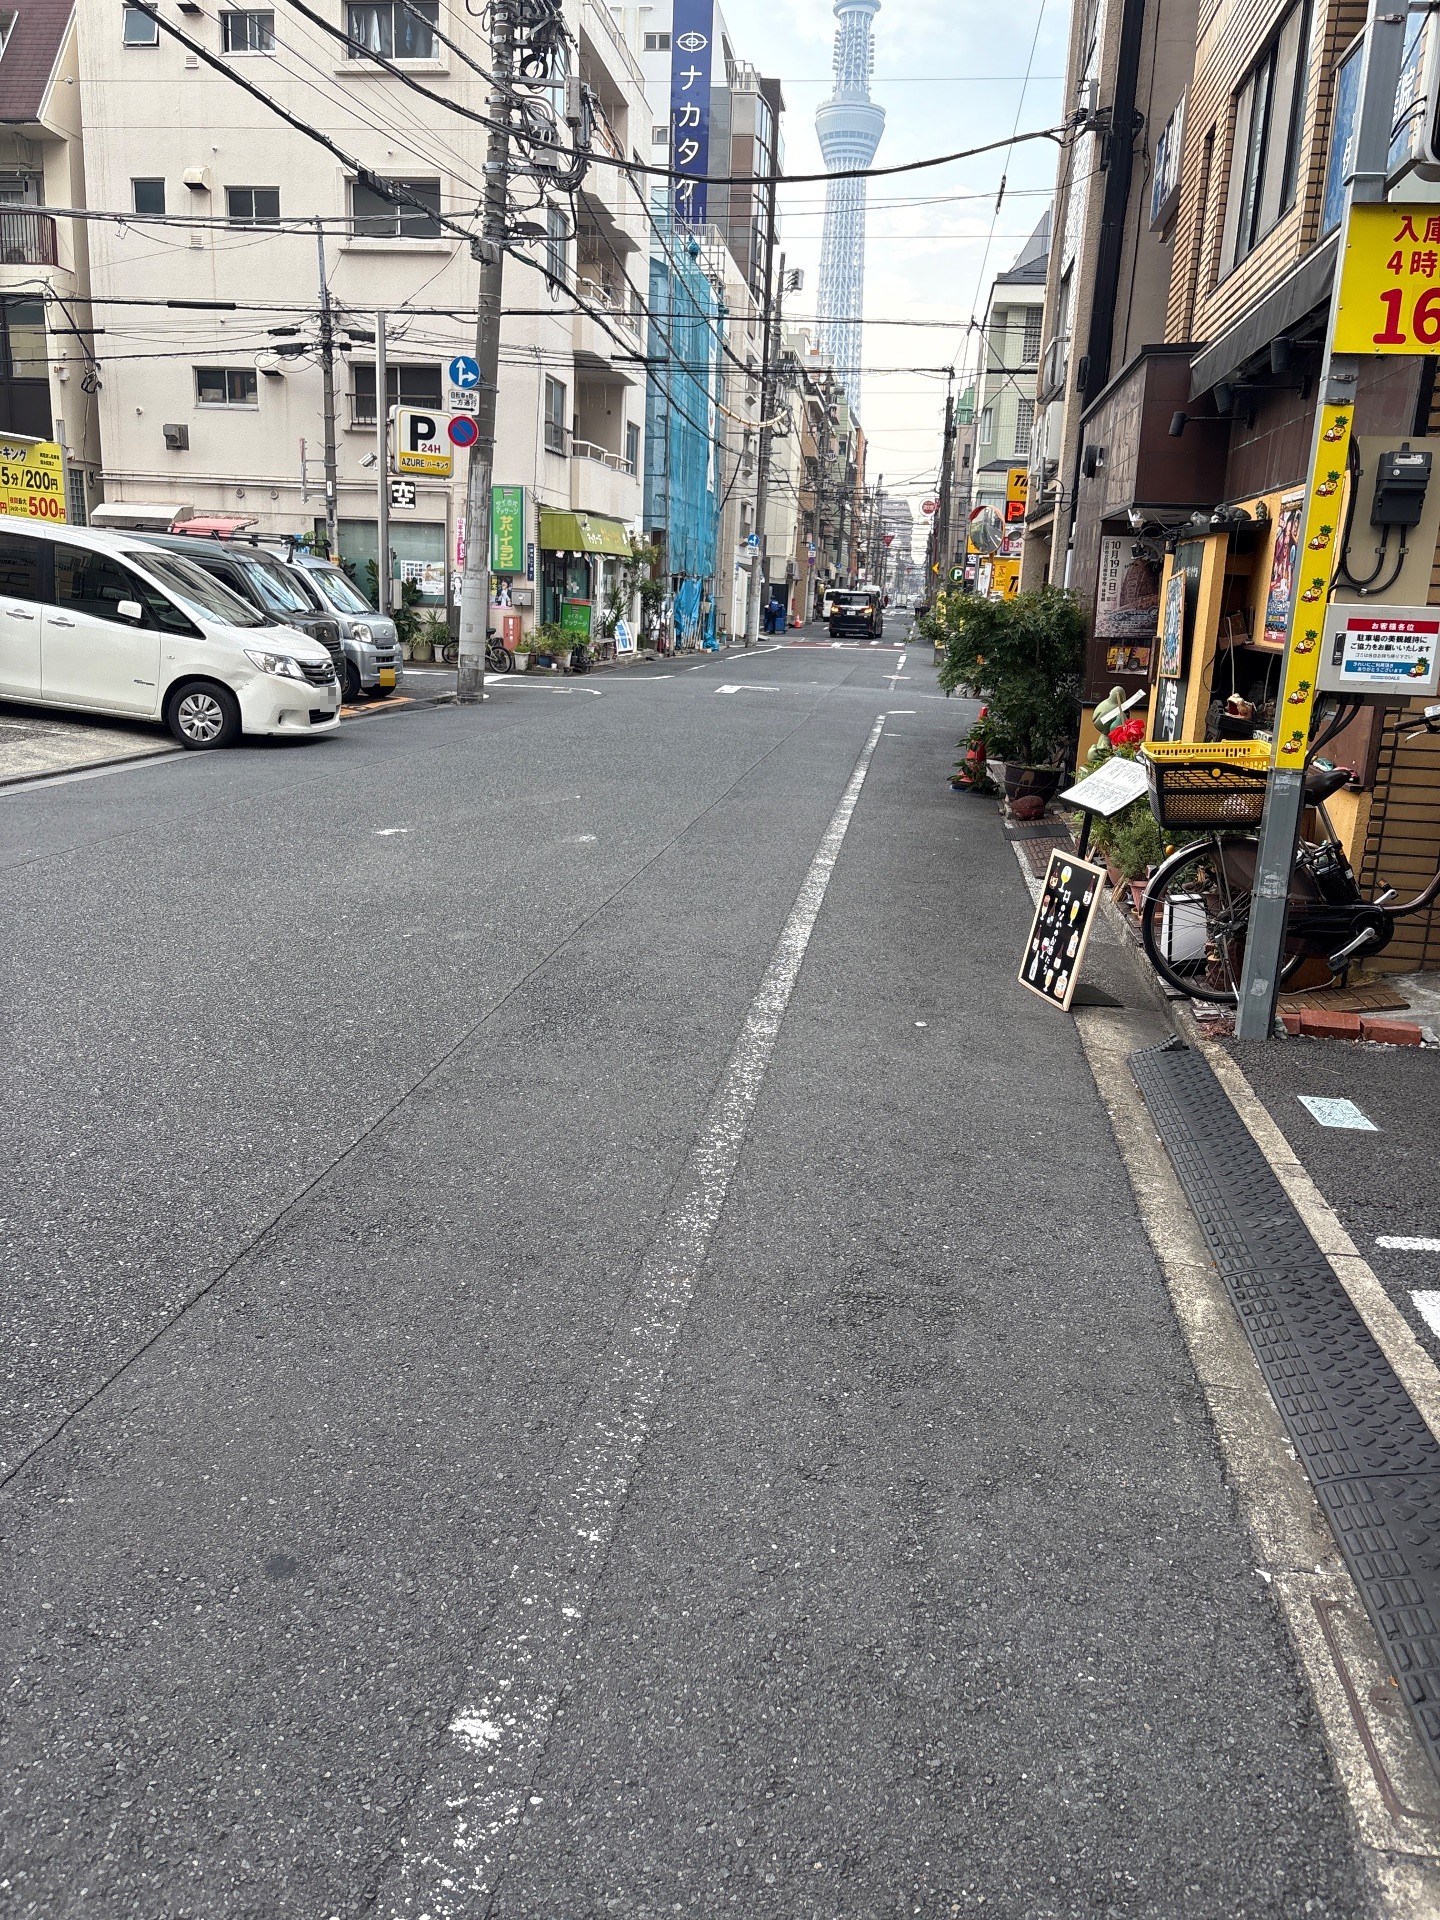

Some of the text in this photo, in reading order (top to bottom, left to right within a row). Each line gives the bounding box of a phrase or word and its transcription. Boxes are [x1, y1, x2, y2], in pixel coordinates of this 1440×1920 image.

[450, 392, 477, 401] 自転車を除く
[410, 414, 436, 452] P
[421, 443, 441, 454] 24H
[401, 457, 449, 469] AZURE パーキング
[392, 481, 415, 508] 空
[495, 507, 519, 515] マッサージ
[1007, 502, 1025, 521] P
[954, 569, 963, 580] P
[1371, 622, 1415, 631] お客様各位
[1357, 633, 1428, 644] 駐車場の美観維持に
[1350, 642, 1431, 653] ご協力をお願いいたします
[1357, 666, 1403, 674] ありがとうございます
